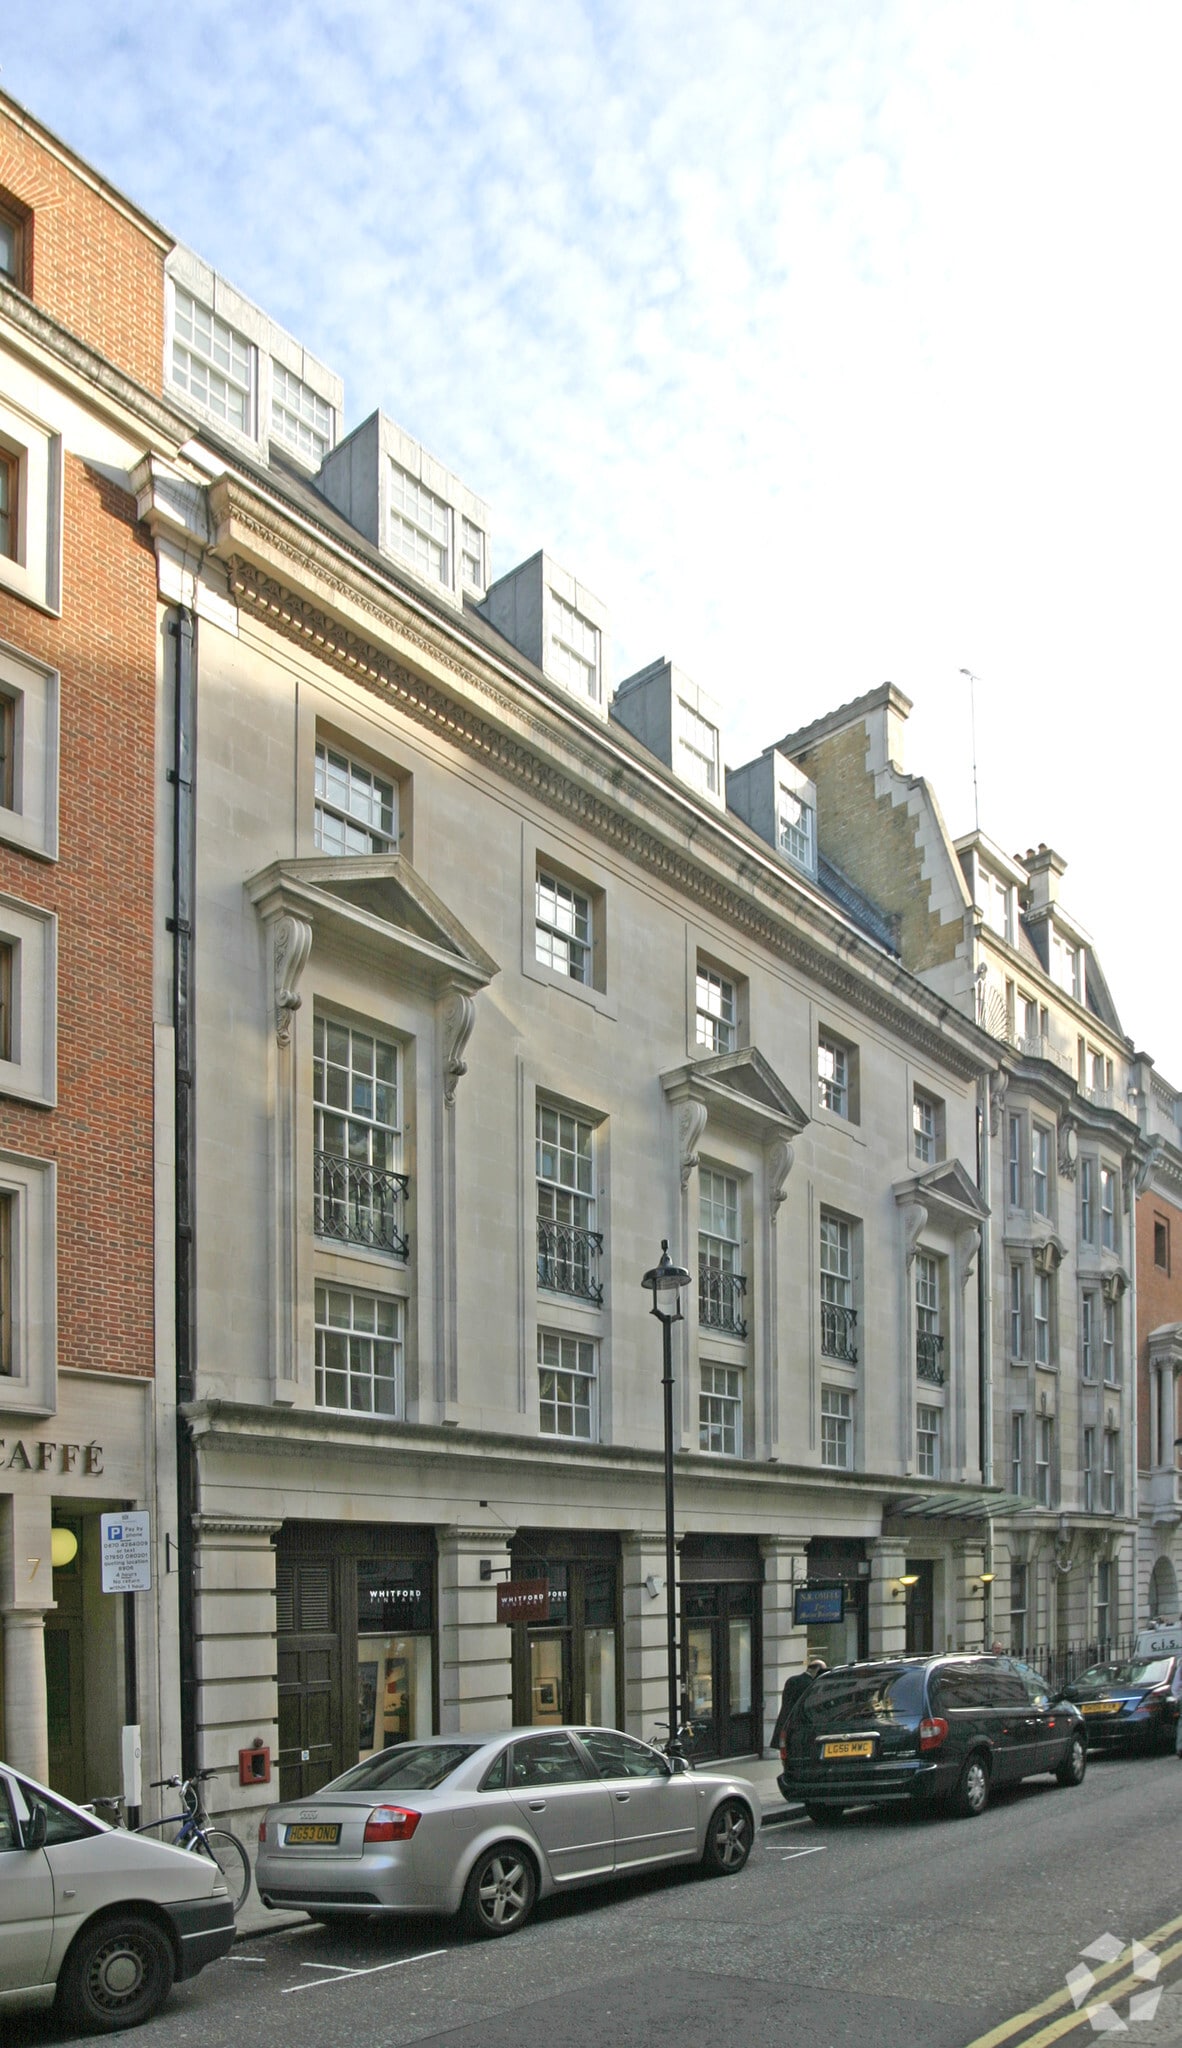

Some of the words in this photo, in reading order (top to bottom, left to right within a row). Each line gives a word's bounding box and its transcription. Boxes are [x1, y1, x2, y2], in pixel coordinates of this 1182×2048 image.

[0, 1439, 104, 1475] AFFÉ
[27, 1558, 41, 1584] 7
[501, 1594, 543, 1602] WHITFORD
[827, 1743, 849, 1754] LG56
[850, 1742, 869, 1752] MWC
